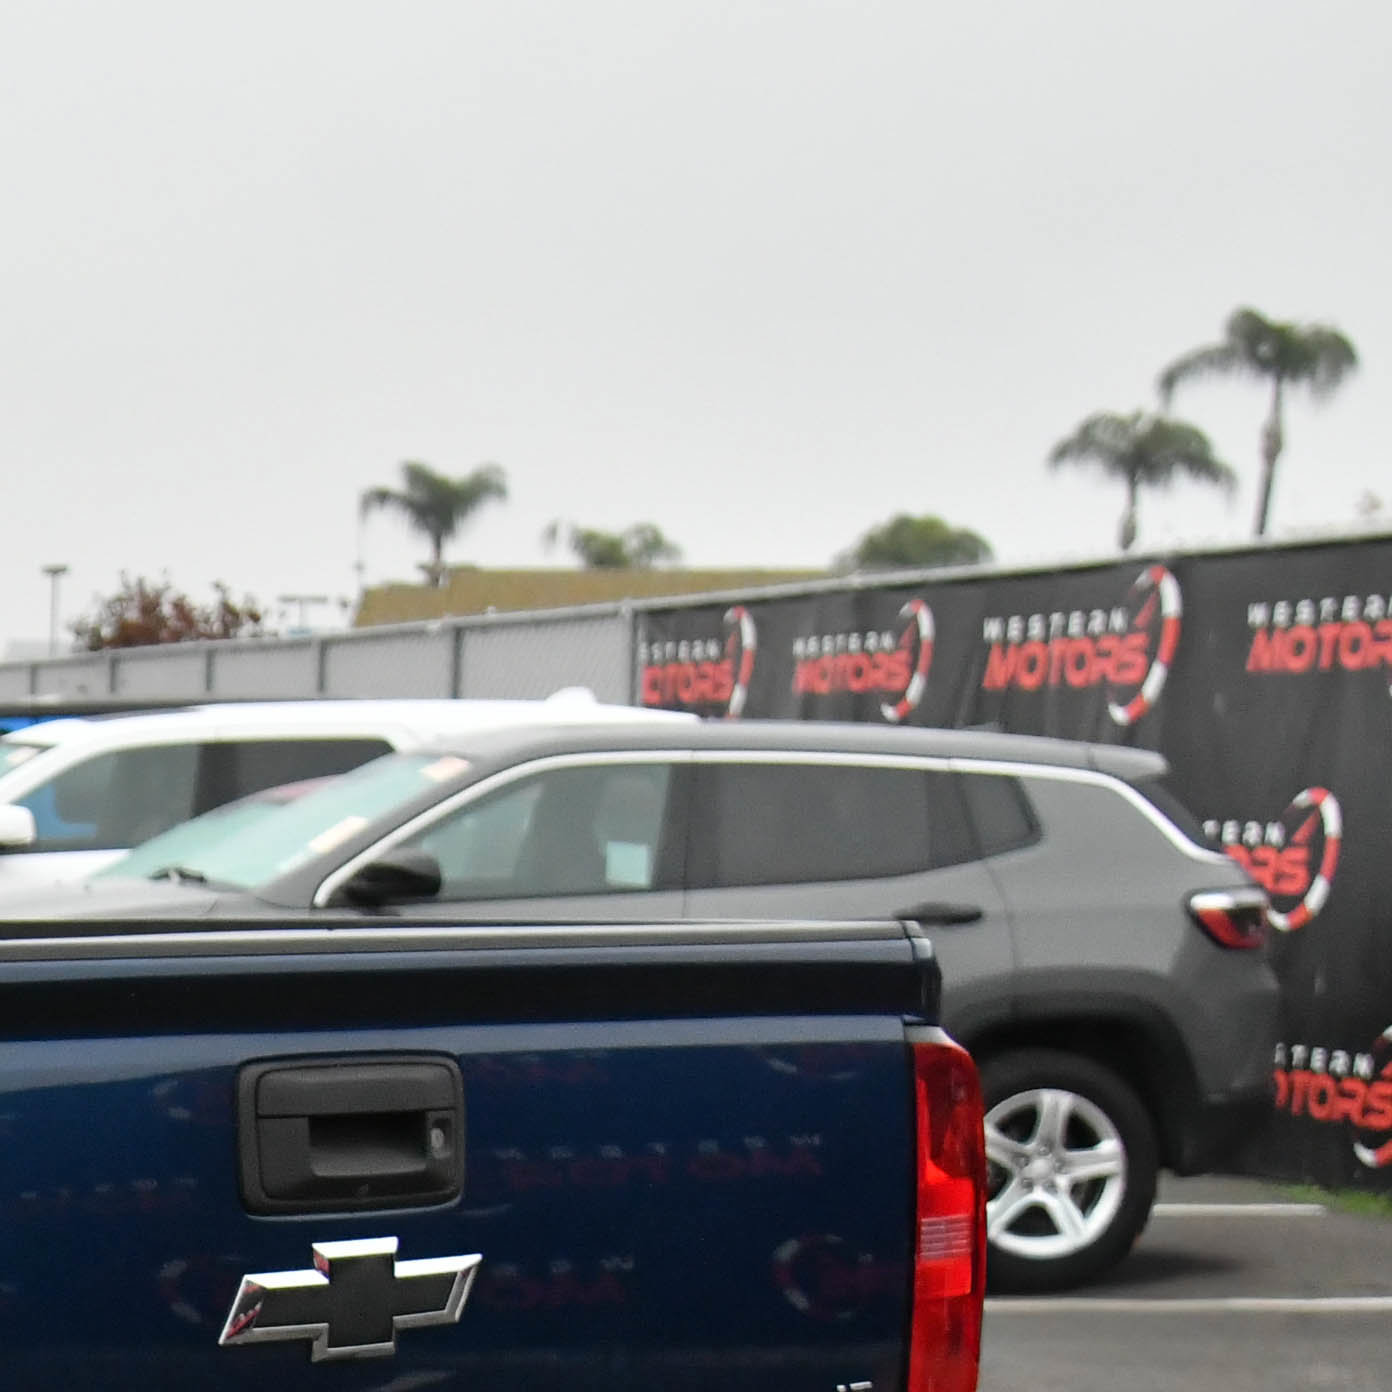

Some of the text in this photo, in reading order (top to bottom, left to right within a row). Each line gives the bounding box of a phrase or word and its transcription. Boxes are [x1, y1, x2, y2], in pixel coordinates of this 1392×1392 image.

[983, 607, 1129, 642] WESTERN
[1247, 594, 1392, 628] WESTER
[640, 639, 720, 661] ESTERN
[982, 632, 1149, 690] MOTORS
[1246, 619, 1392, 673] MOTOR
[643, 659, 734, 704] OTORS
